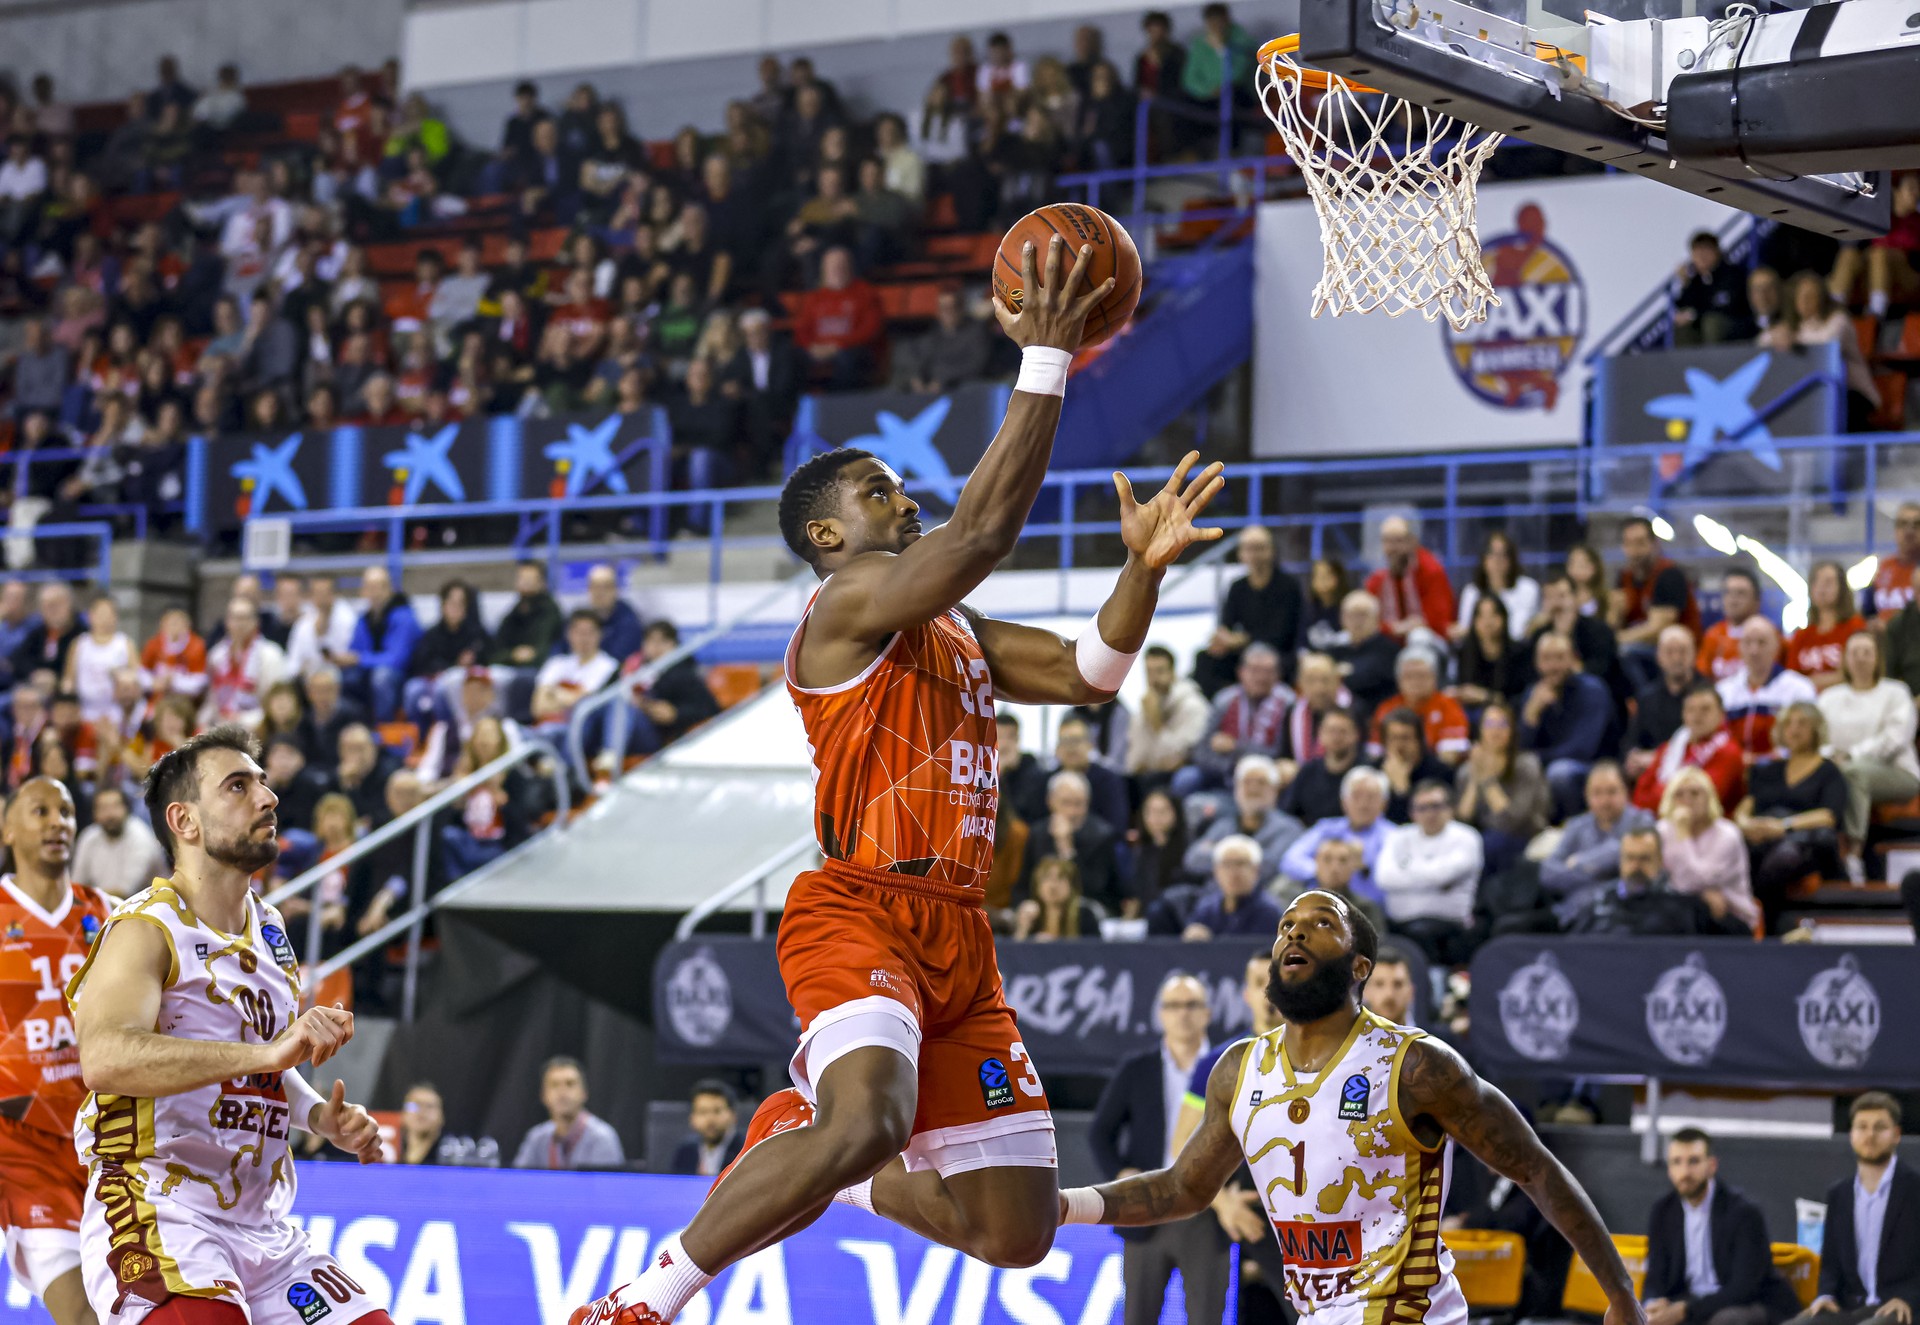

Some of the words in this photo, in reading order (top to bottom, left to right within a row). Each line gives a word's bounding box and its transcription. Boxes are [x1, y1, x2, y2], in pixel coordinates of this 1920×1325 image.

[1451, 283, 1581, 341] AXI
[870, 973, 889, 983] ETL
[869, 981, 901, 994] GLOBAL
[1652, 998, 1723, 1024] BAXI
[1804, 1000, 1876, 1027] BAXI
[988, 1087, 1008, 1098] BKT
[987, 1096, 1014, 1107] EuroCup
[1344, 1101, 1363, 1110] BKT
[217, 1099, 290, 1141] REYE
[1340, 1109, 1366, 1119] EuroCup
[1289, 1140, 1305, 1196] 1
[303, 1300, 320, 1316] BKT
[305, 1306, 329, 1323] EuroCup
